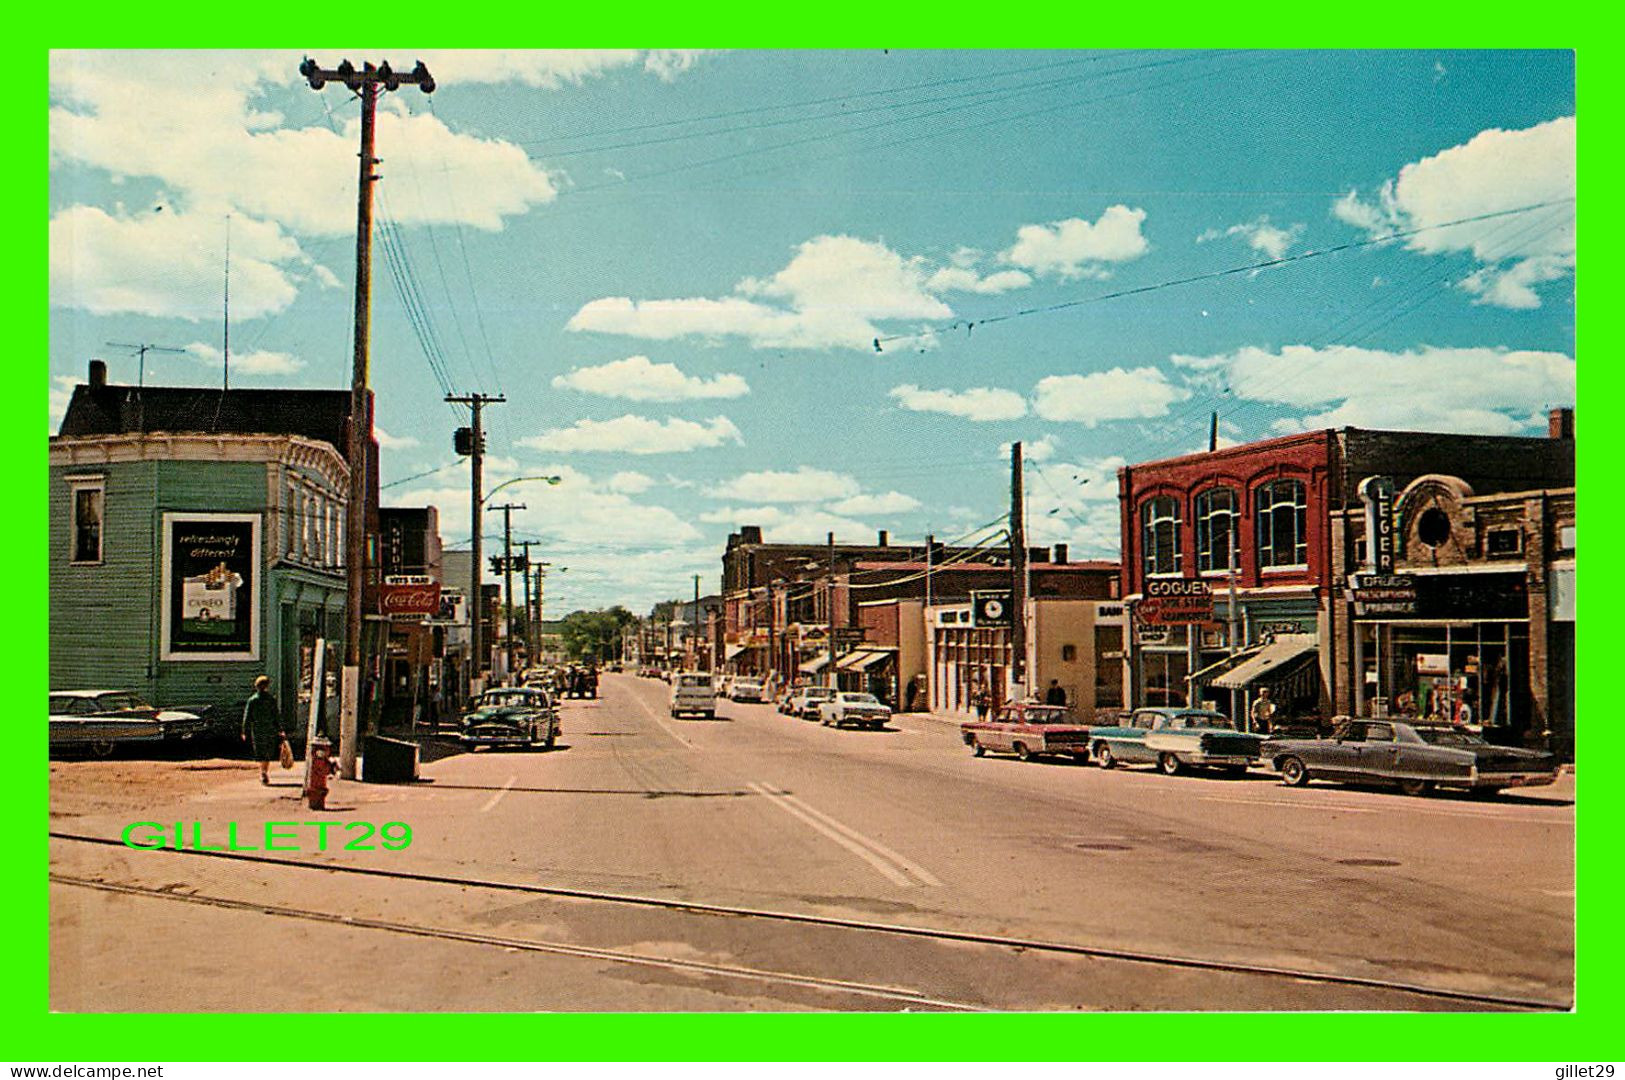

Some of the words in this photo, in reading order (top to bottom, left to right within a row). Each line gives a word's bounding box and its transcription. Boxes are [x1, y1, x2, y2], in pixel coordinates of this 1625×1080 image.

[1377, 487, 1391, 569] LEGER
[179, 534, 240, 546] refreshingly
[1148, 581, 1212, 595] GOGUEN
[1363, 576, 1412, 587] DRUGS
[384, 591, 435, 608] Coca-Cola
[1141, 633, 1165, 641] SHOP
